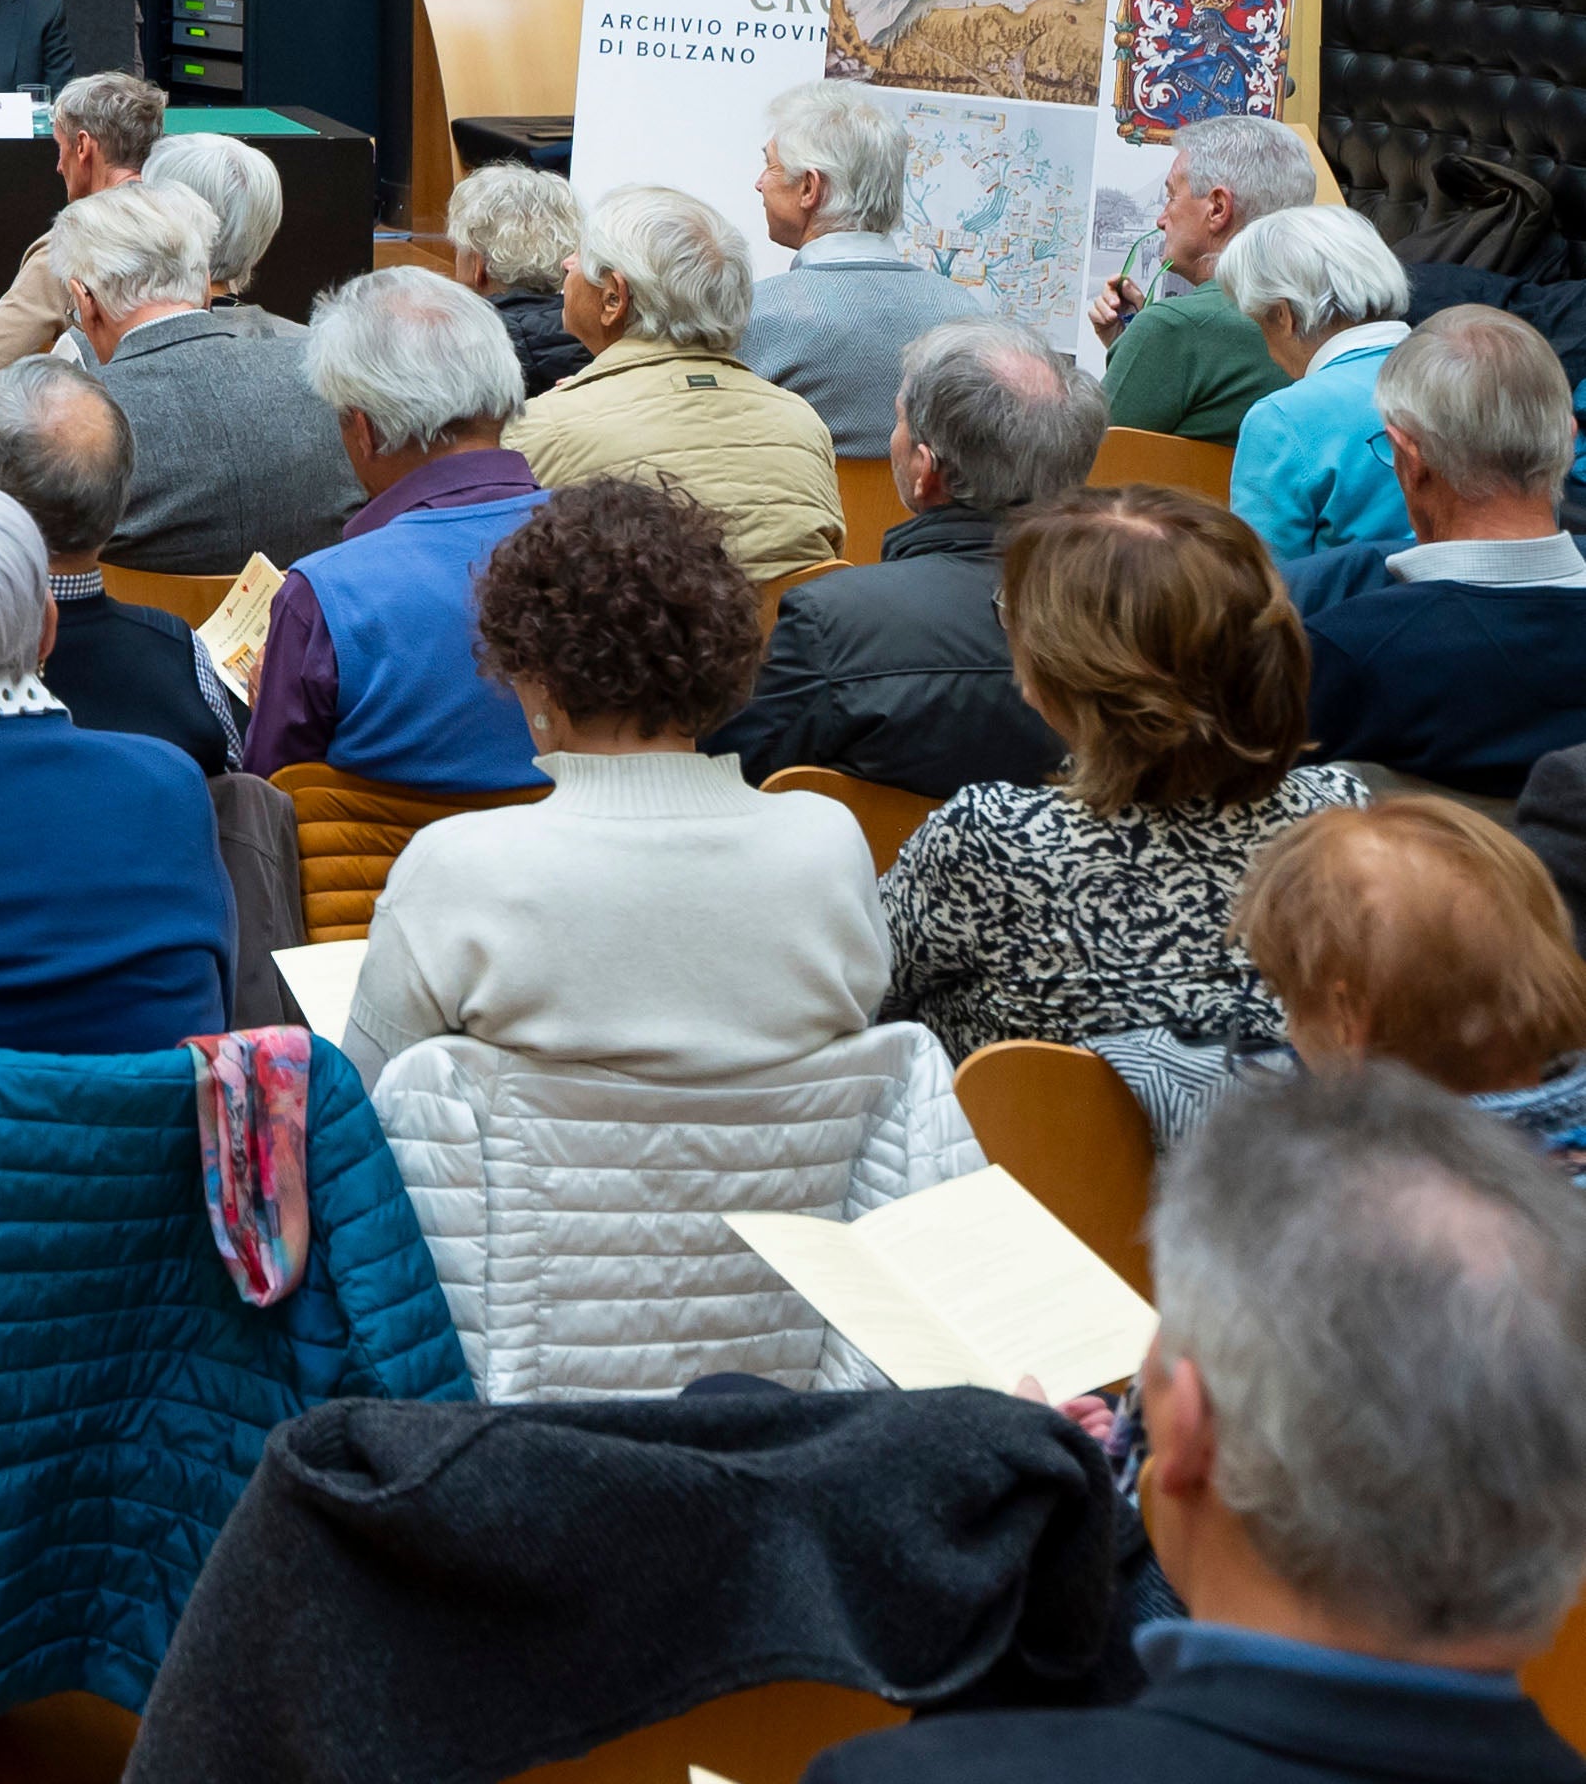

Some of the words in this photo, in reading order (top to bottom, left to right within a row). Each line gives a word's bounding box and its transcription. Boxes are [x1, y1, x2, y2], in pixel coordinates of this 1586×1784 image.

[601, 14, 722, 35] ARCHIVIO
[599, 40, 622, 54] DI
[637, 42, 755, 64] BOLZANO
